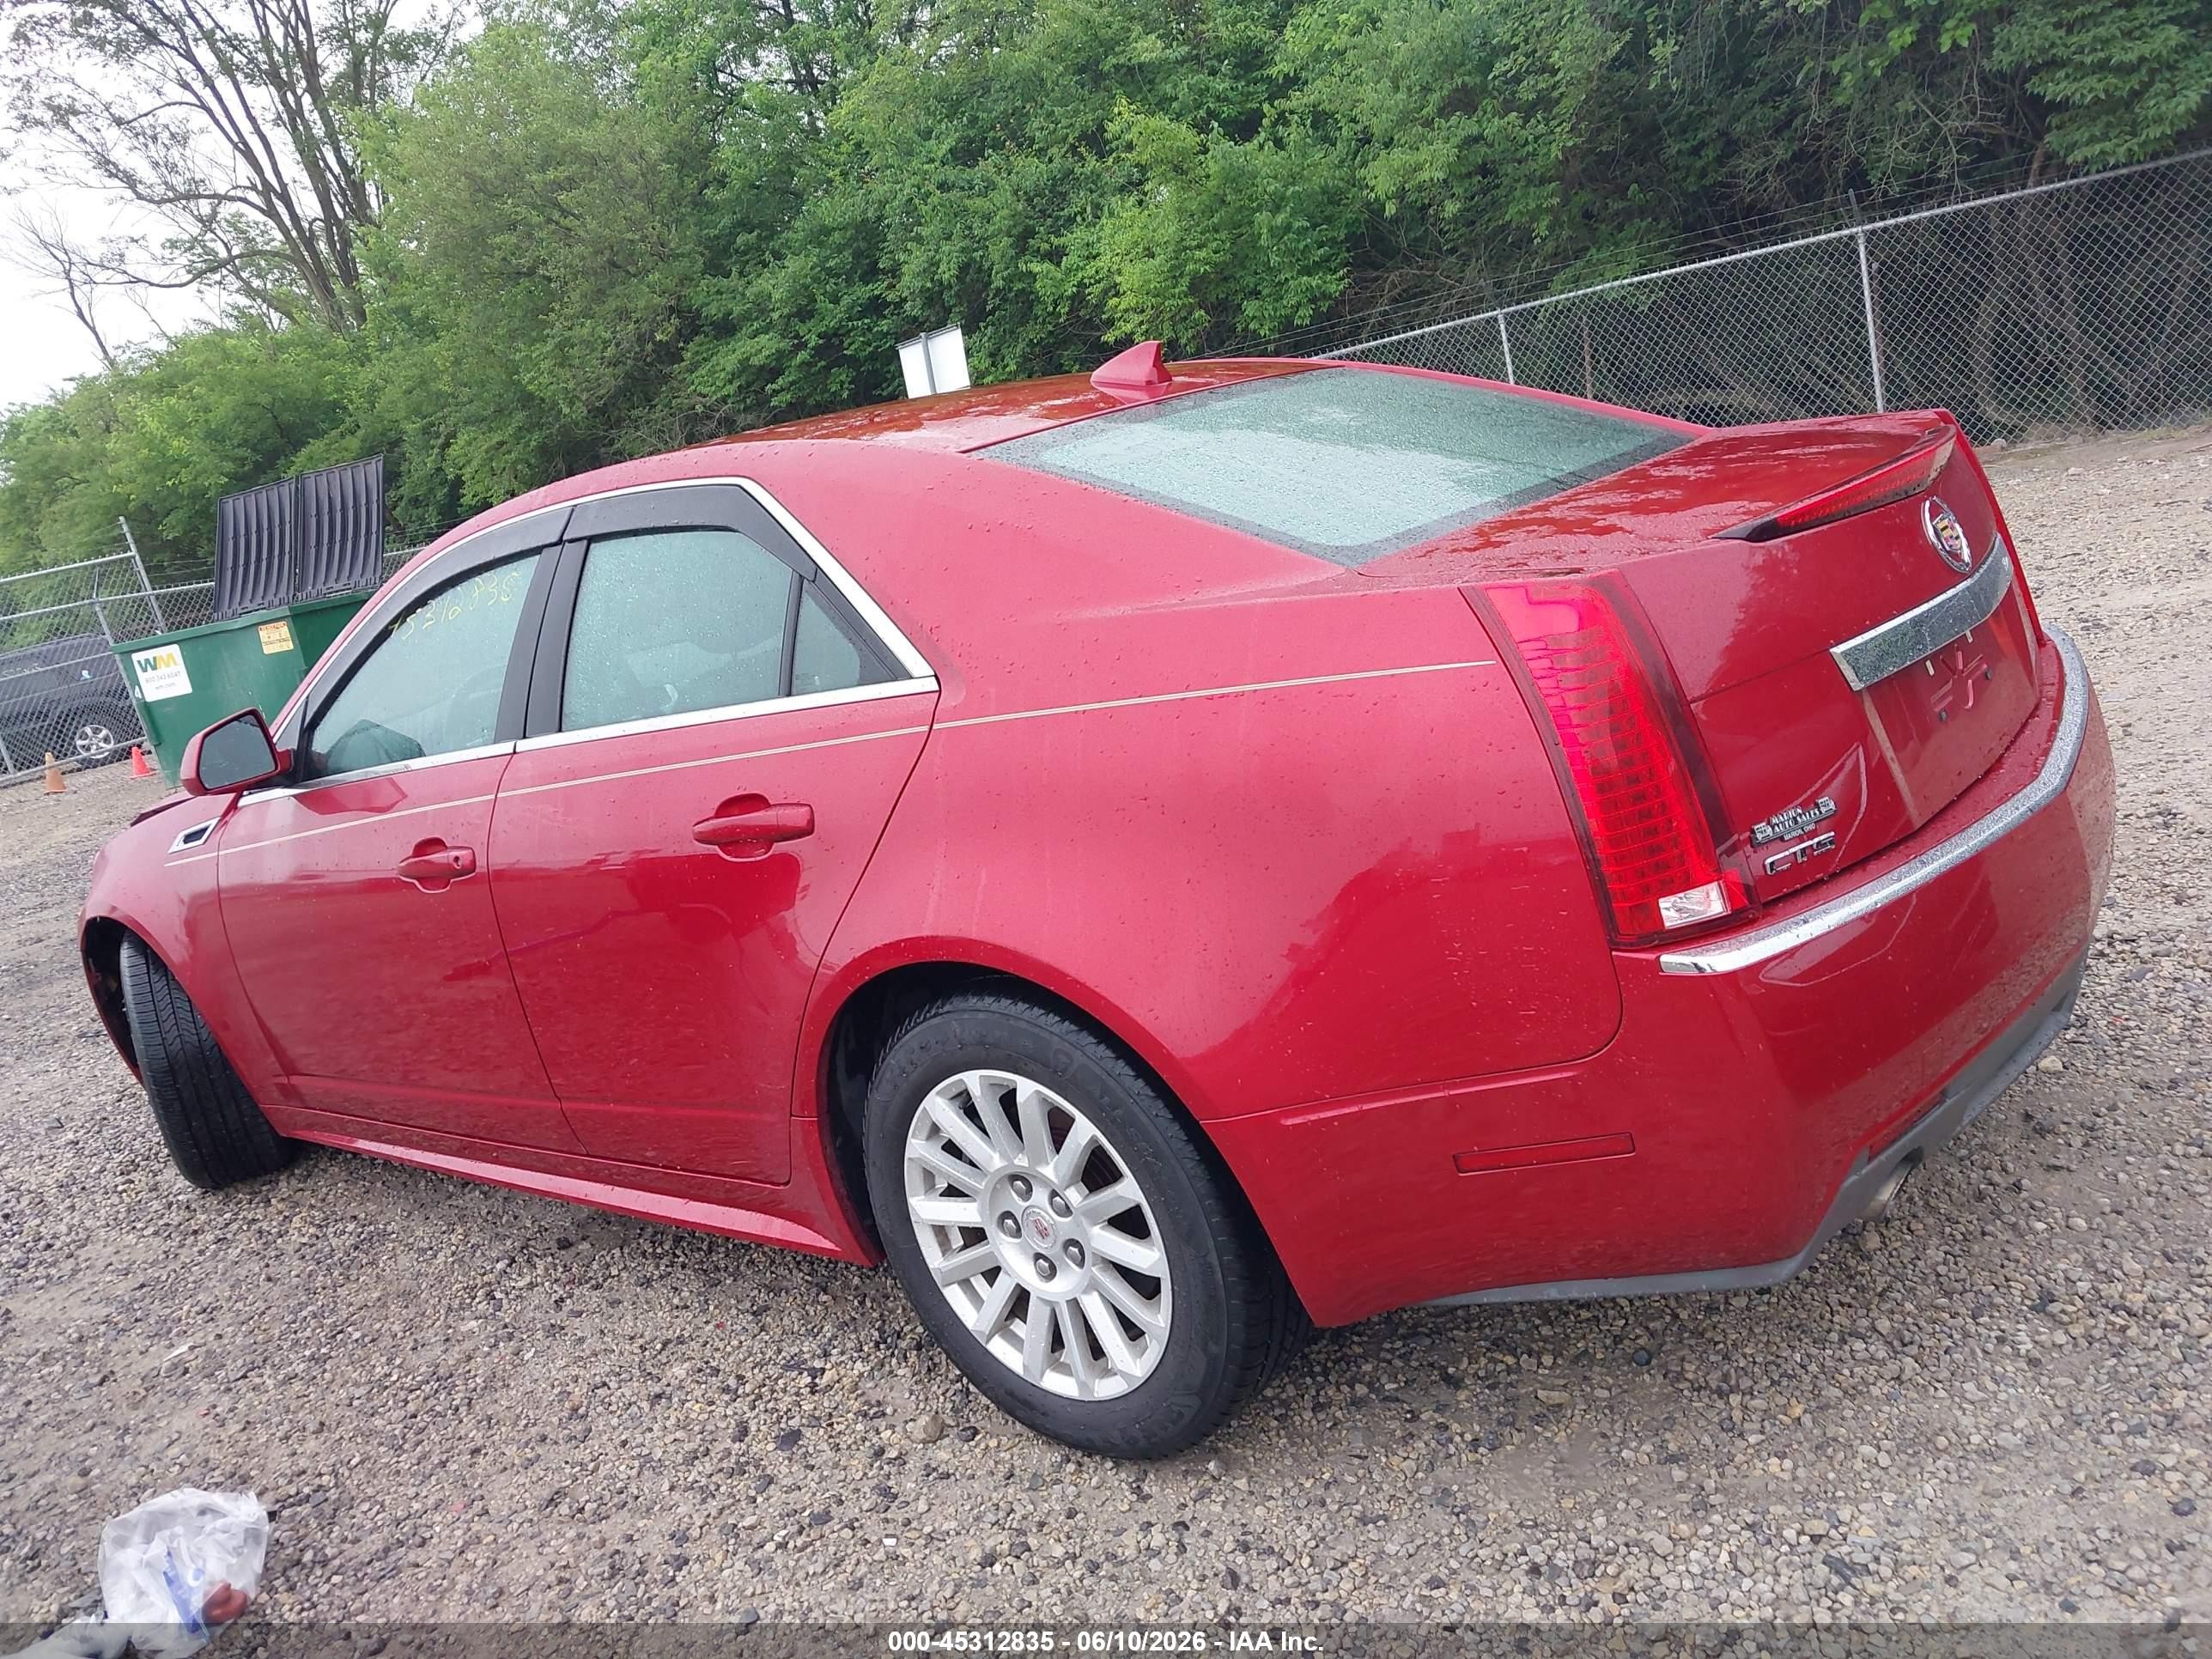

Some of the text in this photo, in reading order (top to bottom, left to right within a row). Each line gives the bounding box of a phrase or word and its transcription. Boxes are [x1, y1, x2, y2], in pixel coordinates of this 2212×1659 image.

[137, 652, 179, 673] WM
[1771, 805, 1802, 824] MARION
[1773, 808, 1820, 834] AUTO SALES
[1765, 830, 1836, 875] CTS
